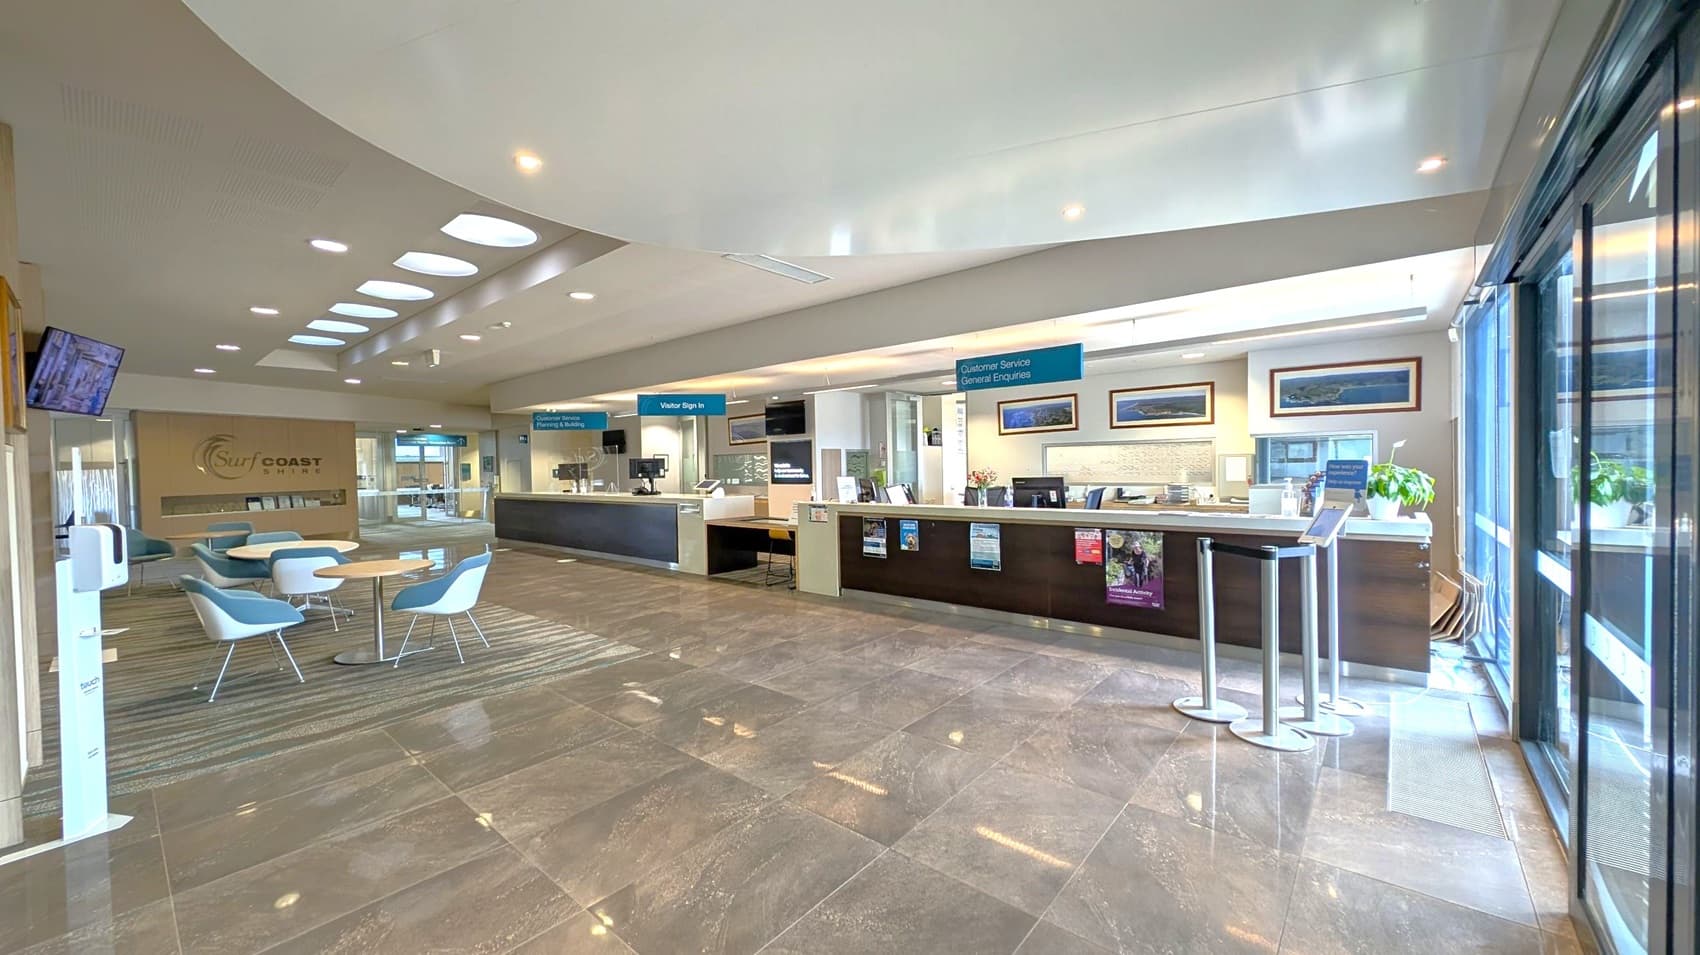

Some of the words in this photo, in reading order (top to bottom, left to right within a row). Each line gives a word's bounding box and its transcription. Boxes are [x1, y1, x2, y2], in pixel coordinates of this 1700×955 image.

[961, 363, 998, 374] Customer
[1000, 358, 1031, 370] Service
[961, 374, 992, 385] General
[994, 370, 1031, 383] Enquiries
[660, 401, 680, 409] Visitor
[682, 401, 697, 410] Sign
[698, 401, 705, 409] In
[536, 421, 559, 429] Planning
[565, 421, 585, 429] Building
[213, 449, 262, 473] Surf
[261, 457, 322, 467] COAST
